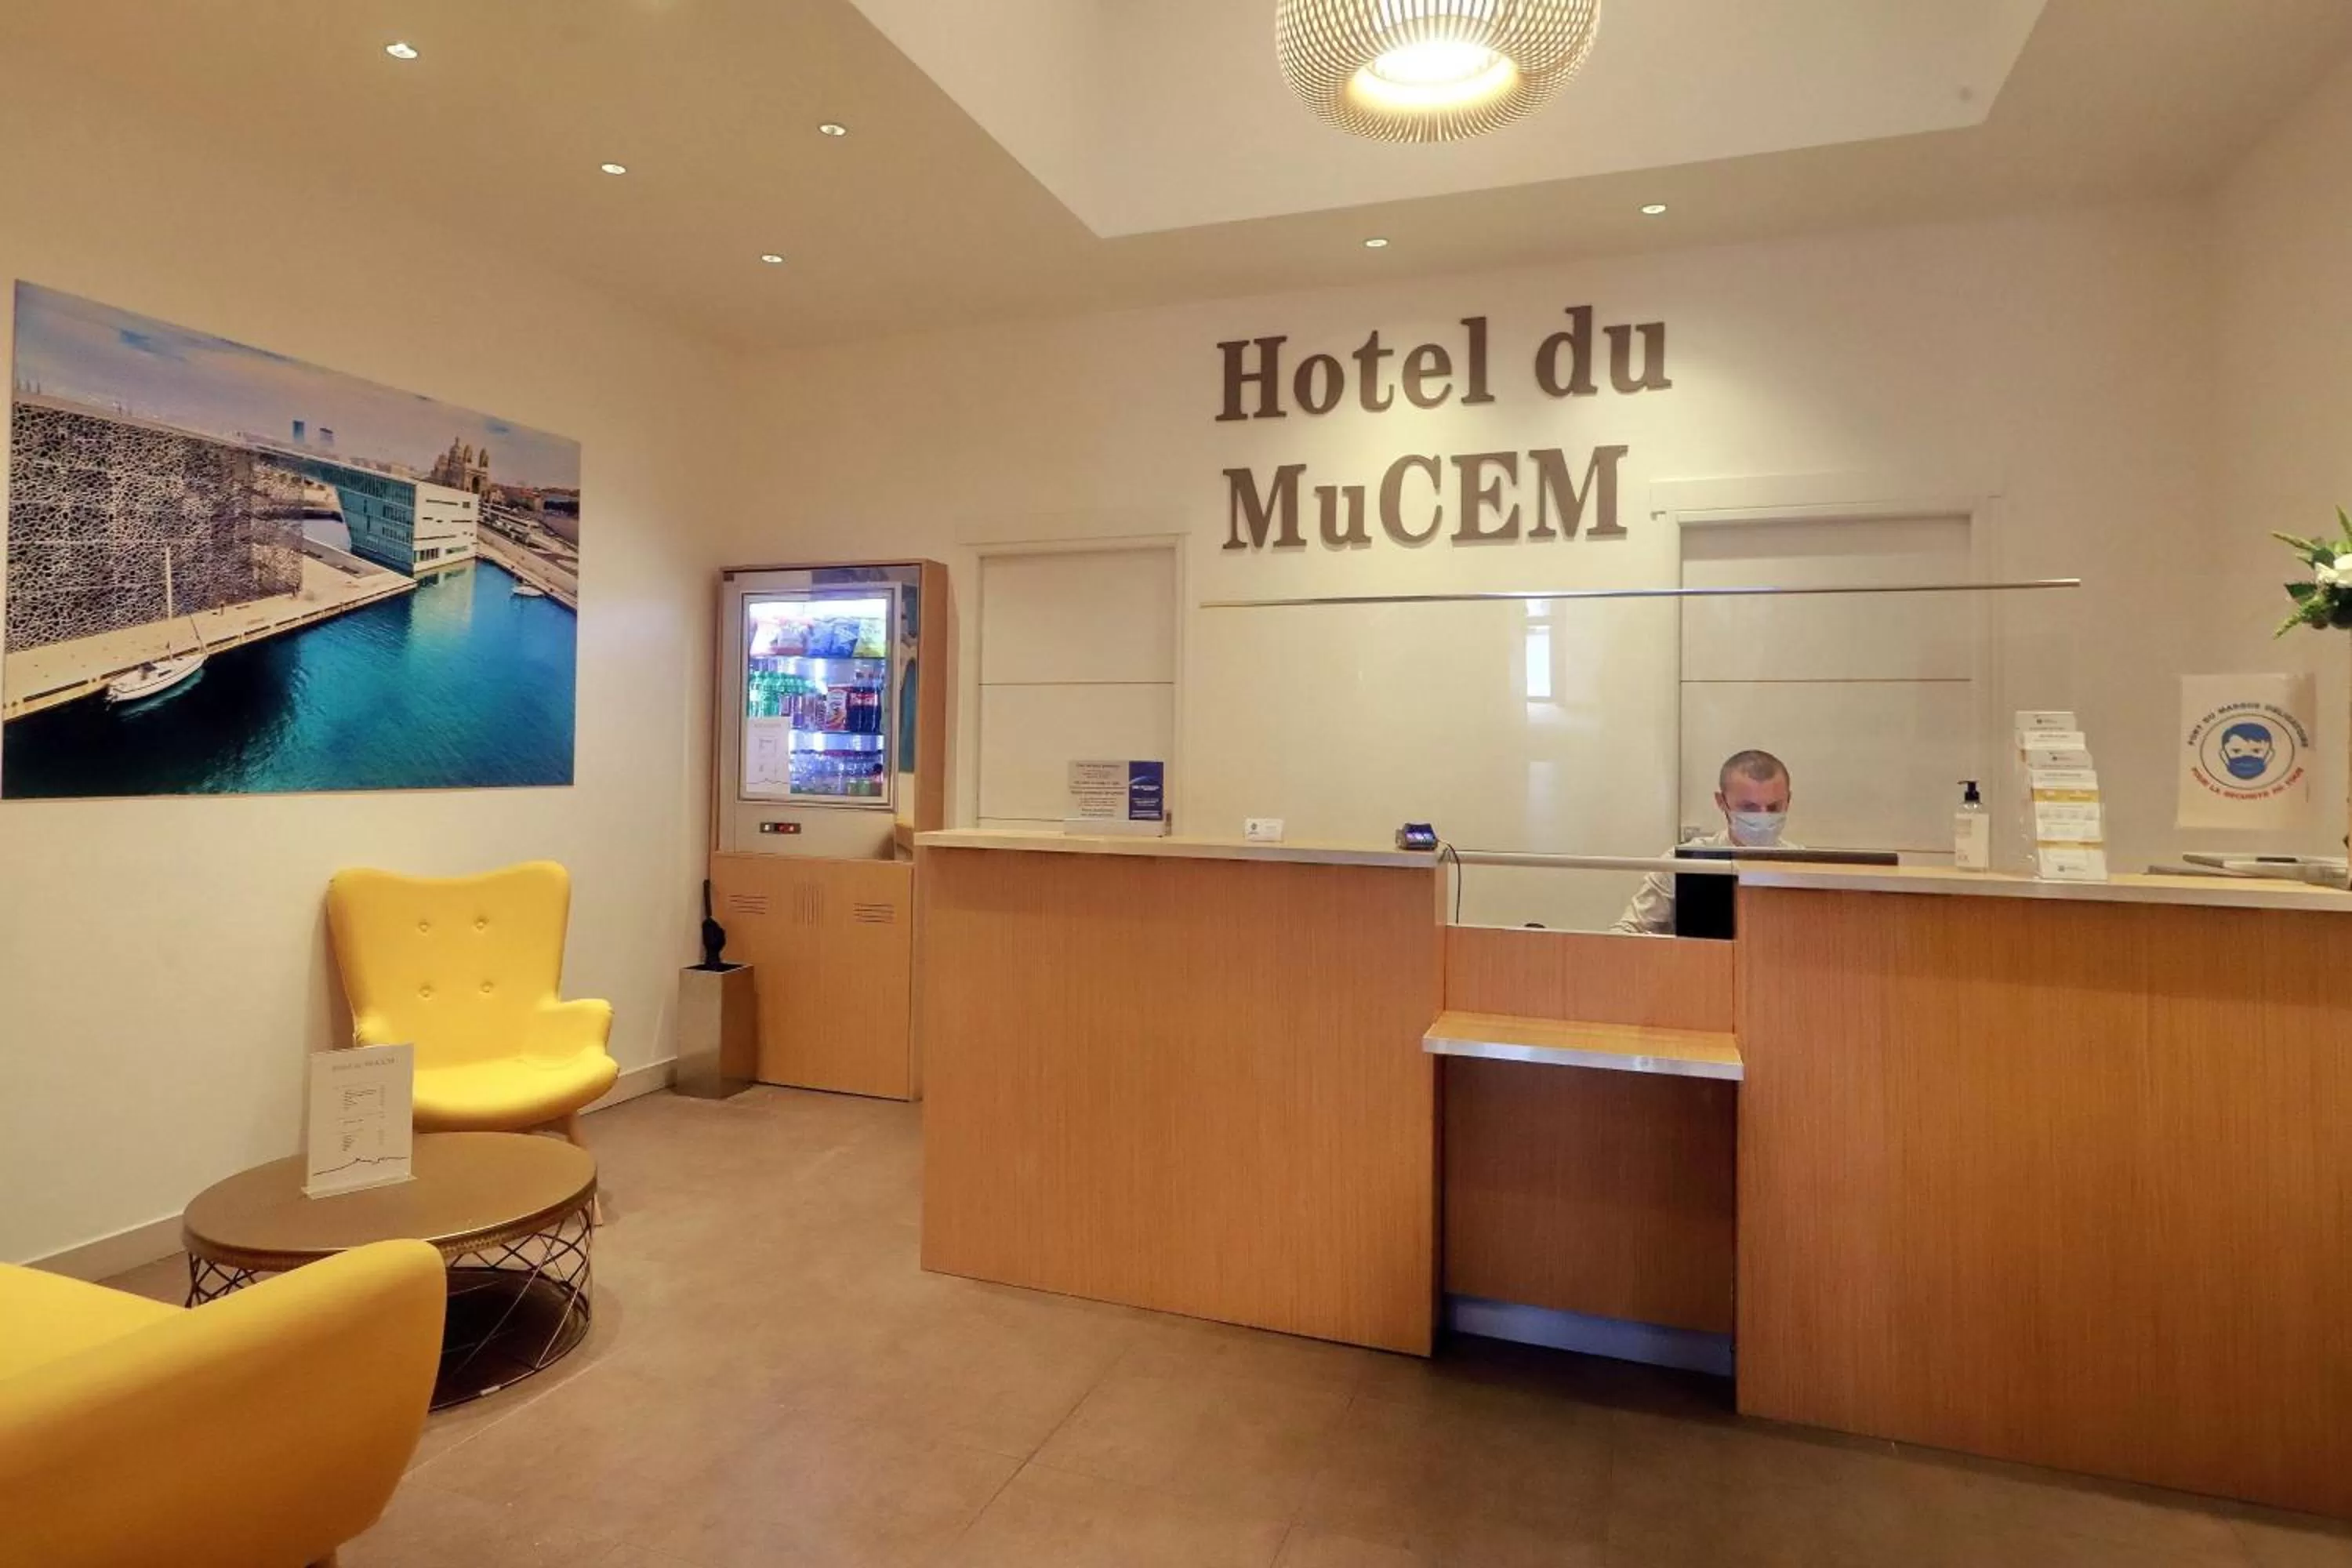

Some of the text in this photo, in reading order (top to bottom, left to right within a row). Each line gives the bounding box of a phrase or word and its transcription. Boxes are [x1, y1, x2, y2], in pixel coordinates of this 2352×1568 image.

[1215, 304, 1673, 422] Hotel du
[1222, 444, 1629, 551] MuCEM
